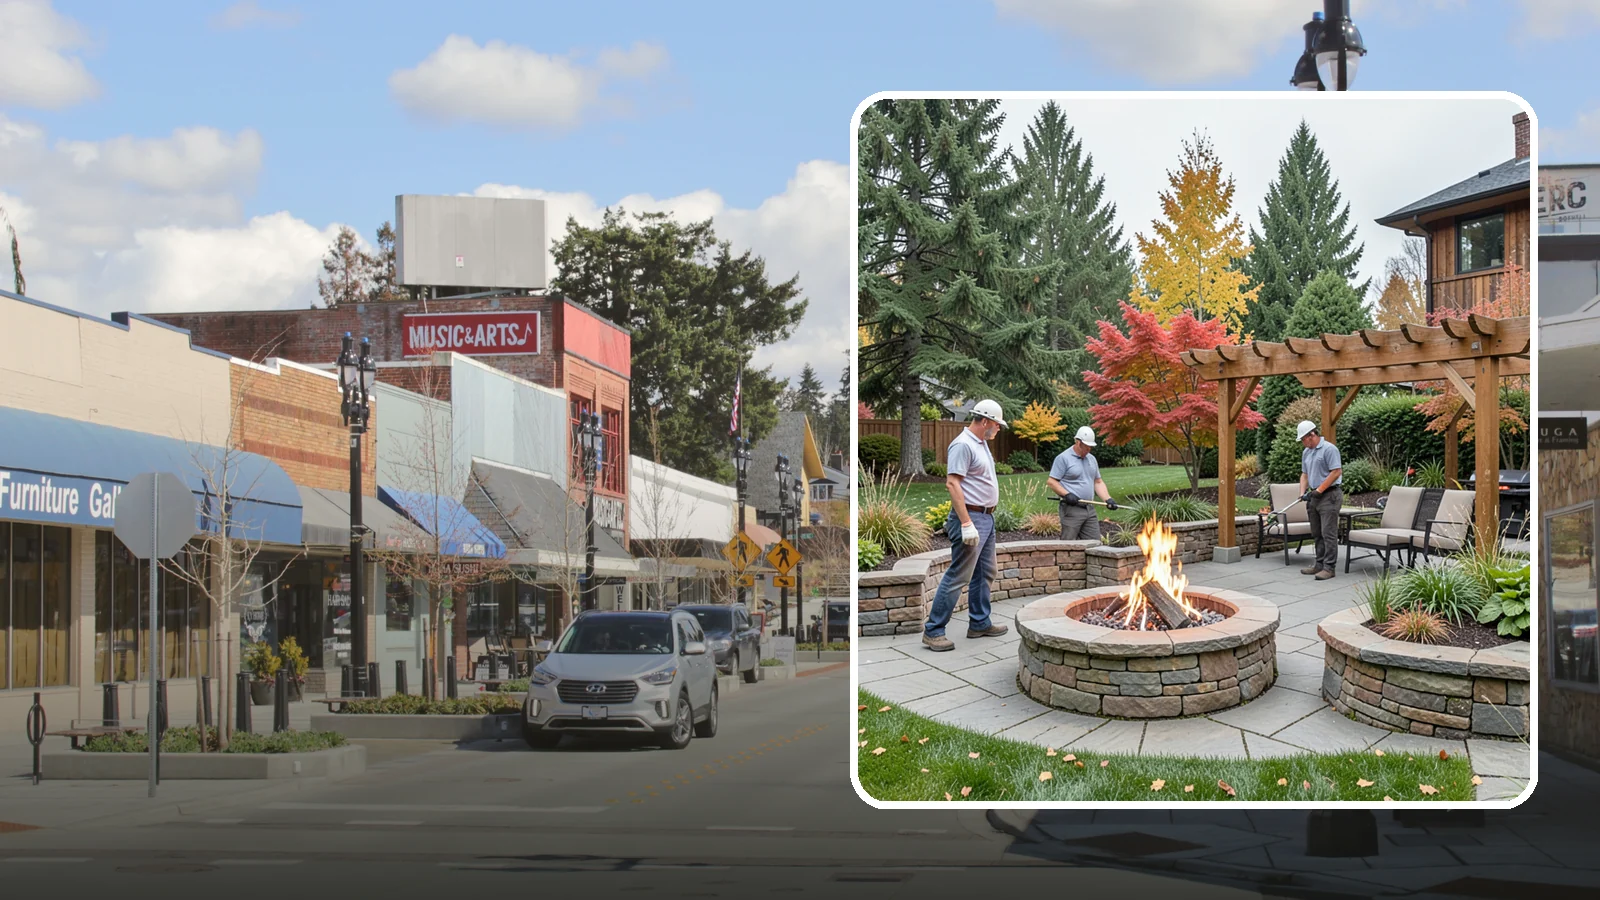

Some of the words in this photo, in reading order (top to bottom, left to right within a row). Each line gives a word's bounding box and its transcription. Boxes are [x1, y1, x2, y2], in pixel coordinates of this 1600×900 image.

[409, 323, 519, 349] MUSIC&ARTS
[0, 471, 79, 515] Furniture
[90, 482, 121, 519] Gal
[453, 563, 479, 574] SUSHI
